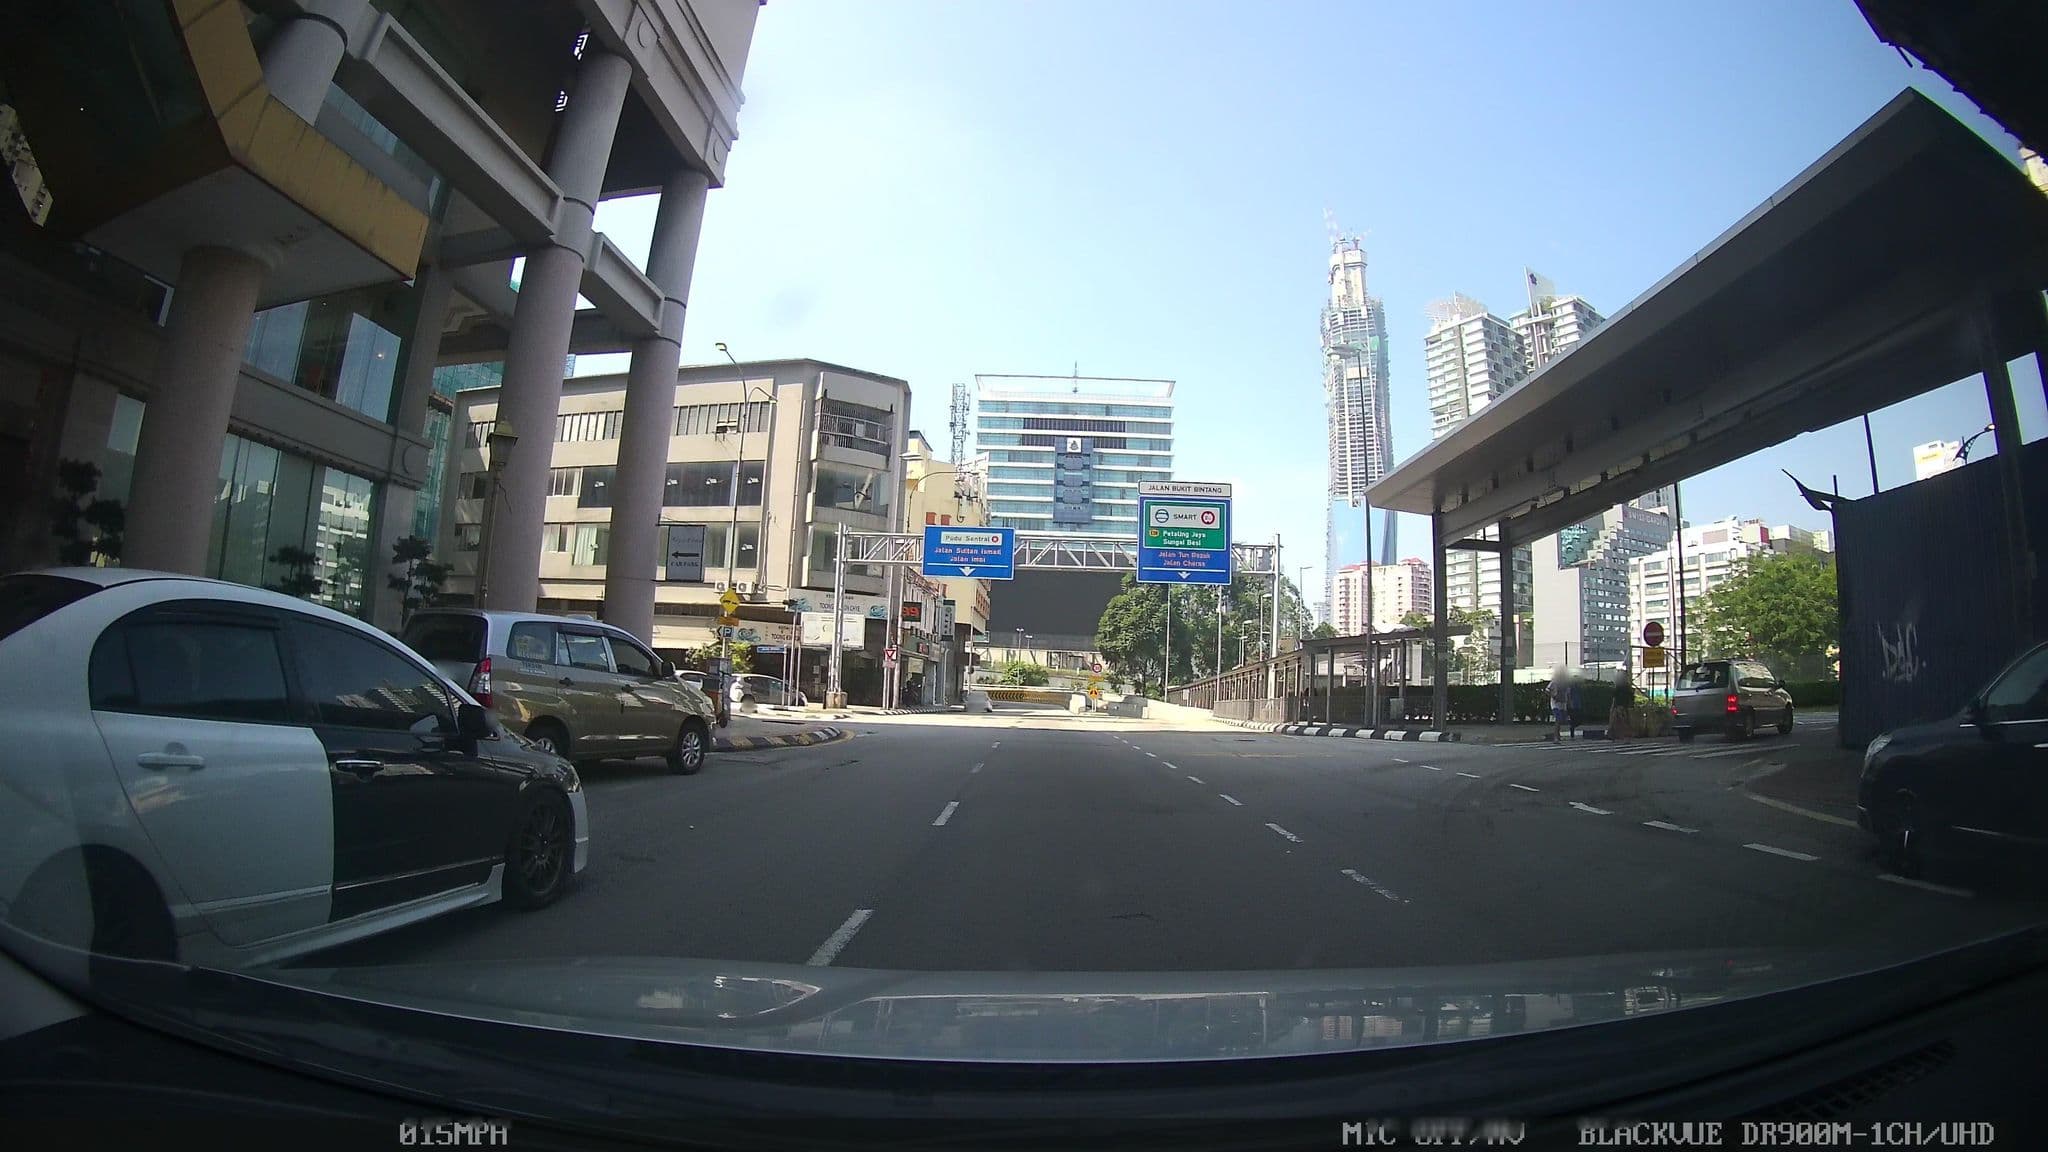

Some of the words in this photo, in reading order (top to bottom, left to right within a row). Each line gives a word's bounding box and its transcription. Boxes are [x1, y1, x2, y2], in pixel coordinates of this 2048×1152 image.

[1163, 530, 1190, 538] Petaling
[1191, 531, 1206, 539] Jaya
[956, 547, 978, 555] Sultan
[1163, 559, 1180, 567] Jalan
